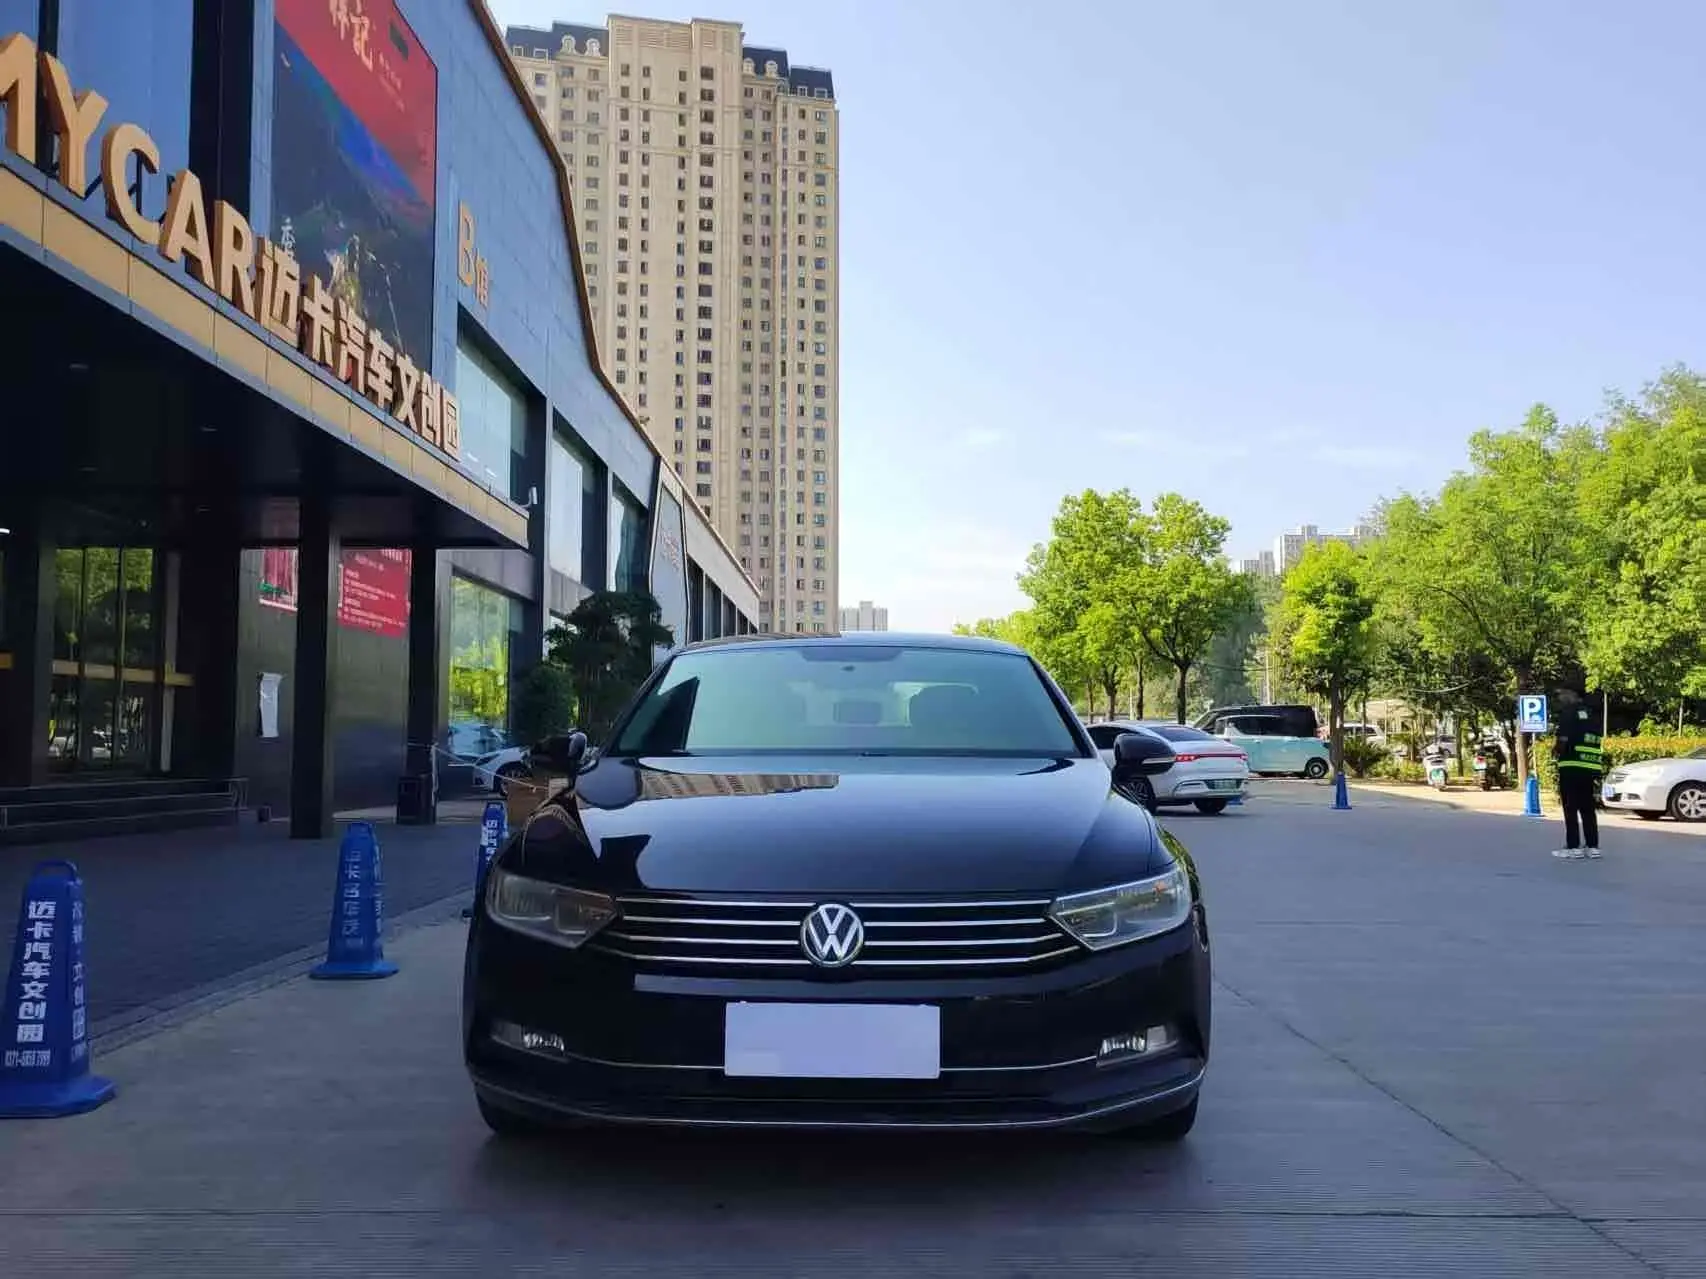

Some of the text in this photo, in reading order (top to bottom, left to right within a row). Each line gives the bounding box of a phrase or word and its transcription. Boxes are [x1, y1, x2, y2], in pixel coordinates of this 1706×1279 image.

[255, 238, 461, 462] 迈卡汽车文创园
[1523, 697, 1542, 721] P
[16, 900, 57, 1044] 迈卡汽车文创园
